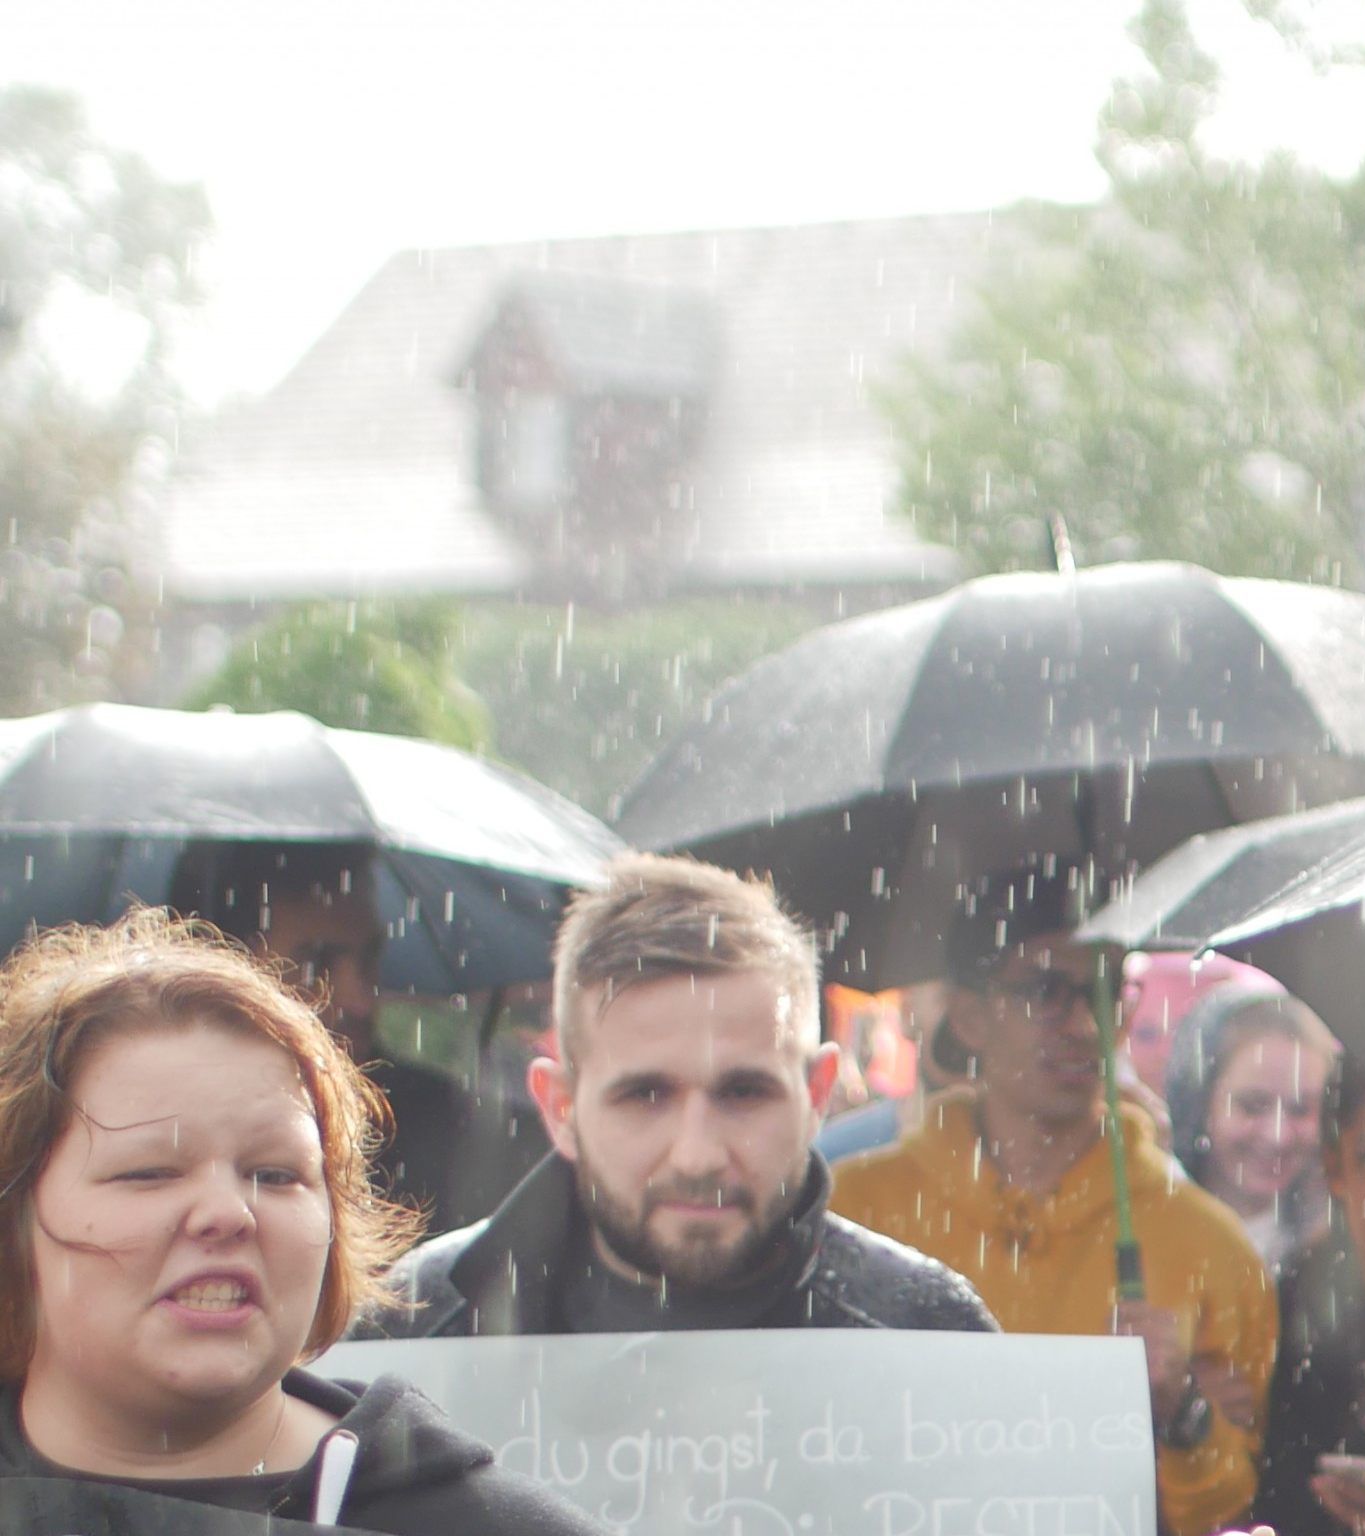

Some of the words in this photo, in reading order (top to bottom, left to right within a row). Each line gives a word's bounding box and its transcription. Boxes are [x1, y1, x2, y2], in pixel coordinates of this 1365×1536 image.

[498, 1386, 590, 1486] du
[600, 1394, 778, 1527] gingst,
[800, 1397, 866, 1468] da
[901, 1386, 1077, 1463] brach
[1089, 1410, 1150, 1453] es
